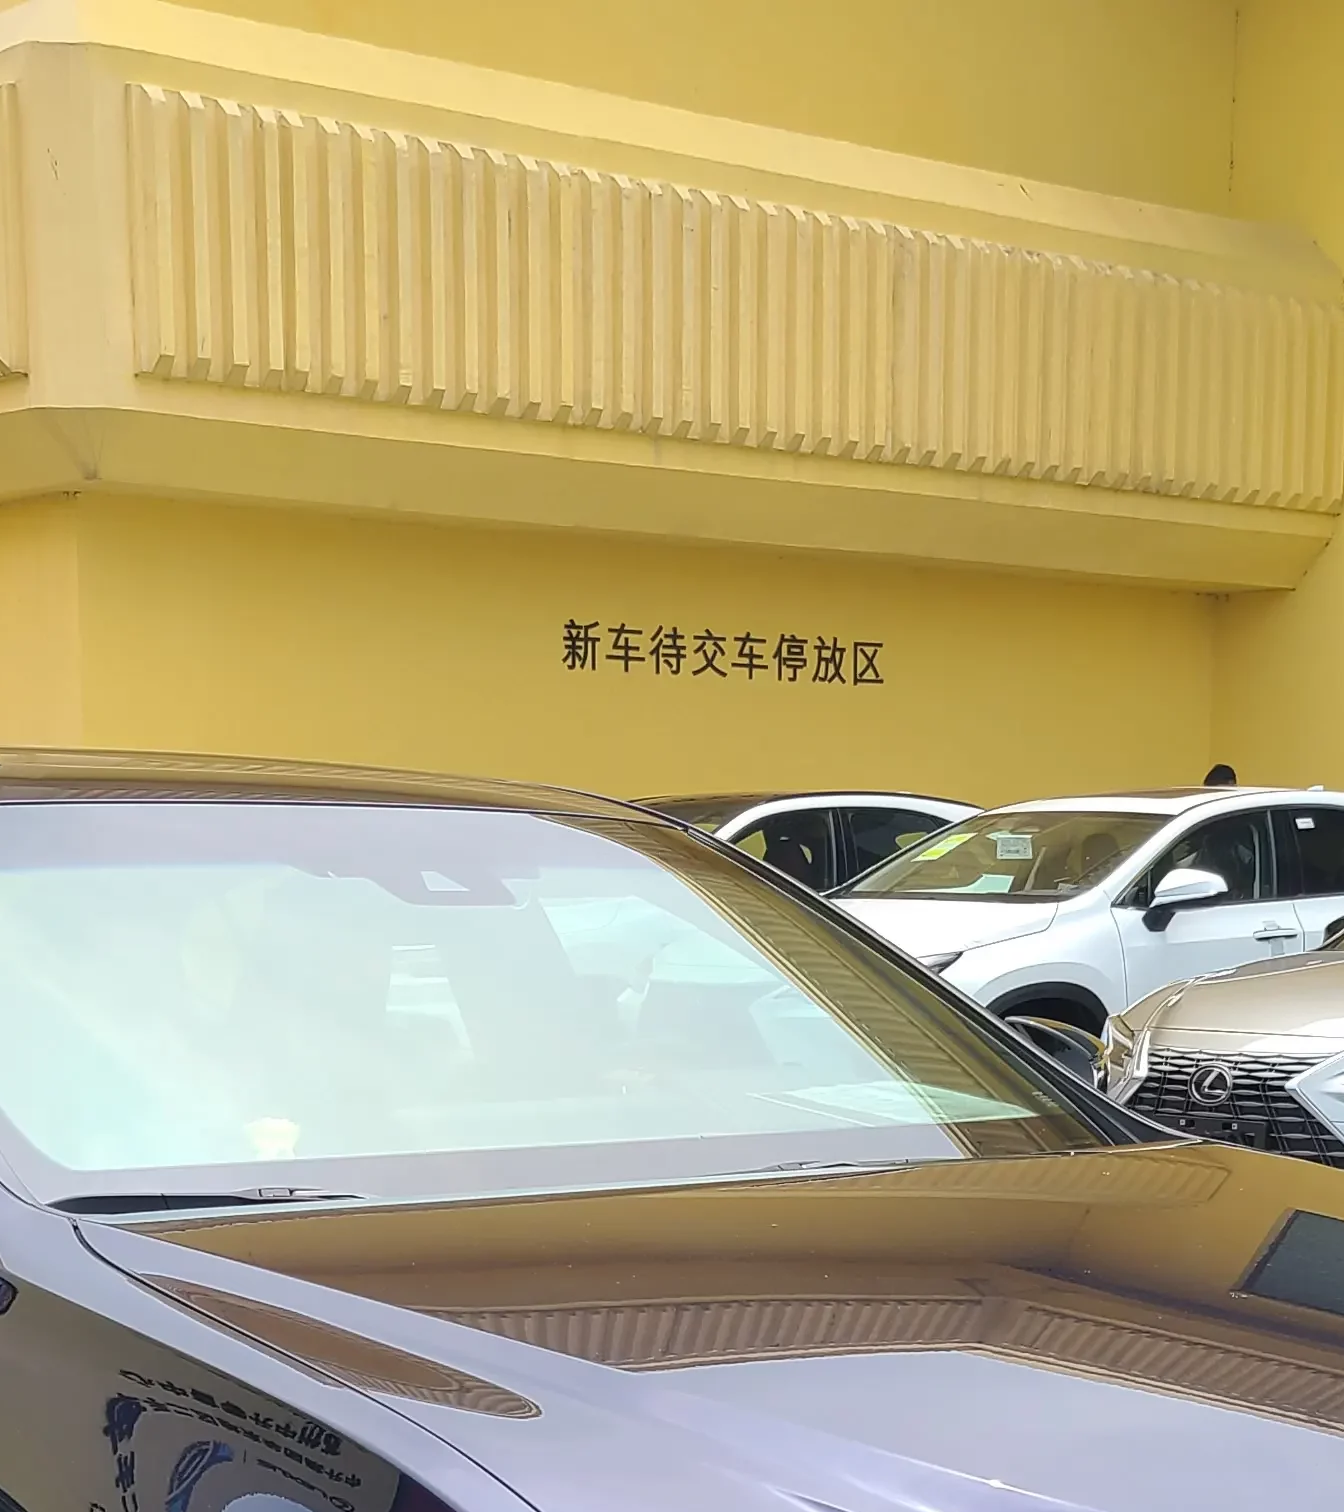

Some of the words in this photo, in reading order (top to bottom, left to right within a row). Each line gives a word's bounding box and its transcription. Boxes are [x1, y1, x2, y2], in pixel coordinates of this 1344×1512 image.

[561, 618, 885, 686] 新车待交车停放区
